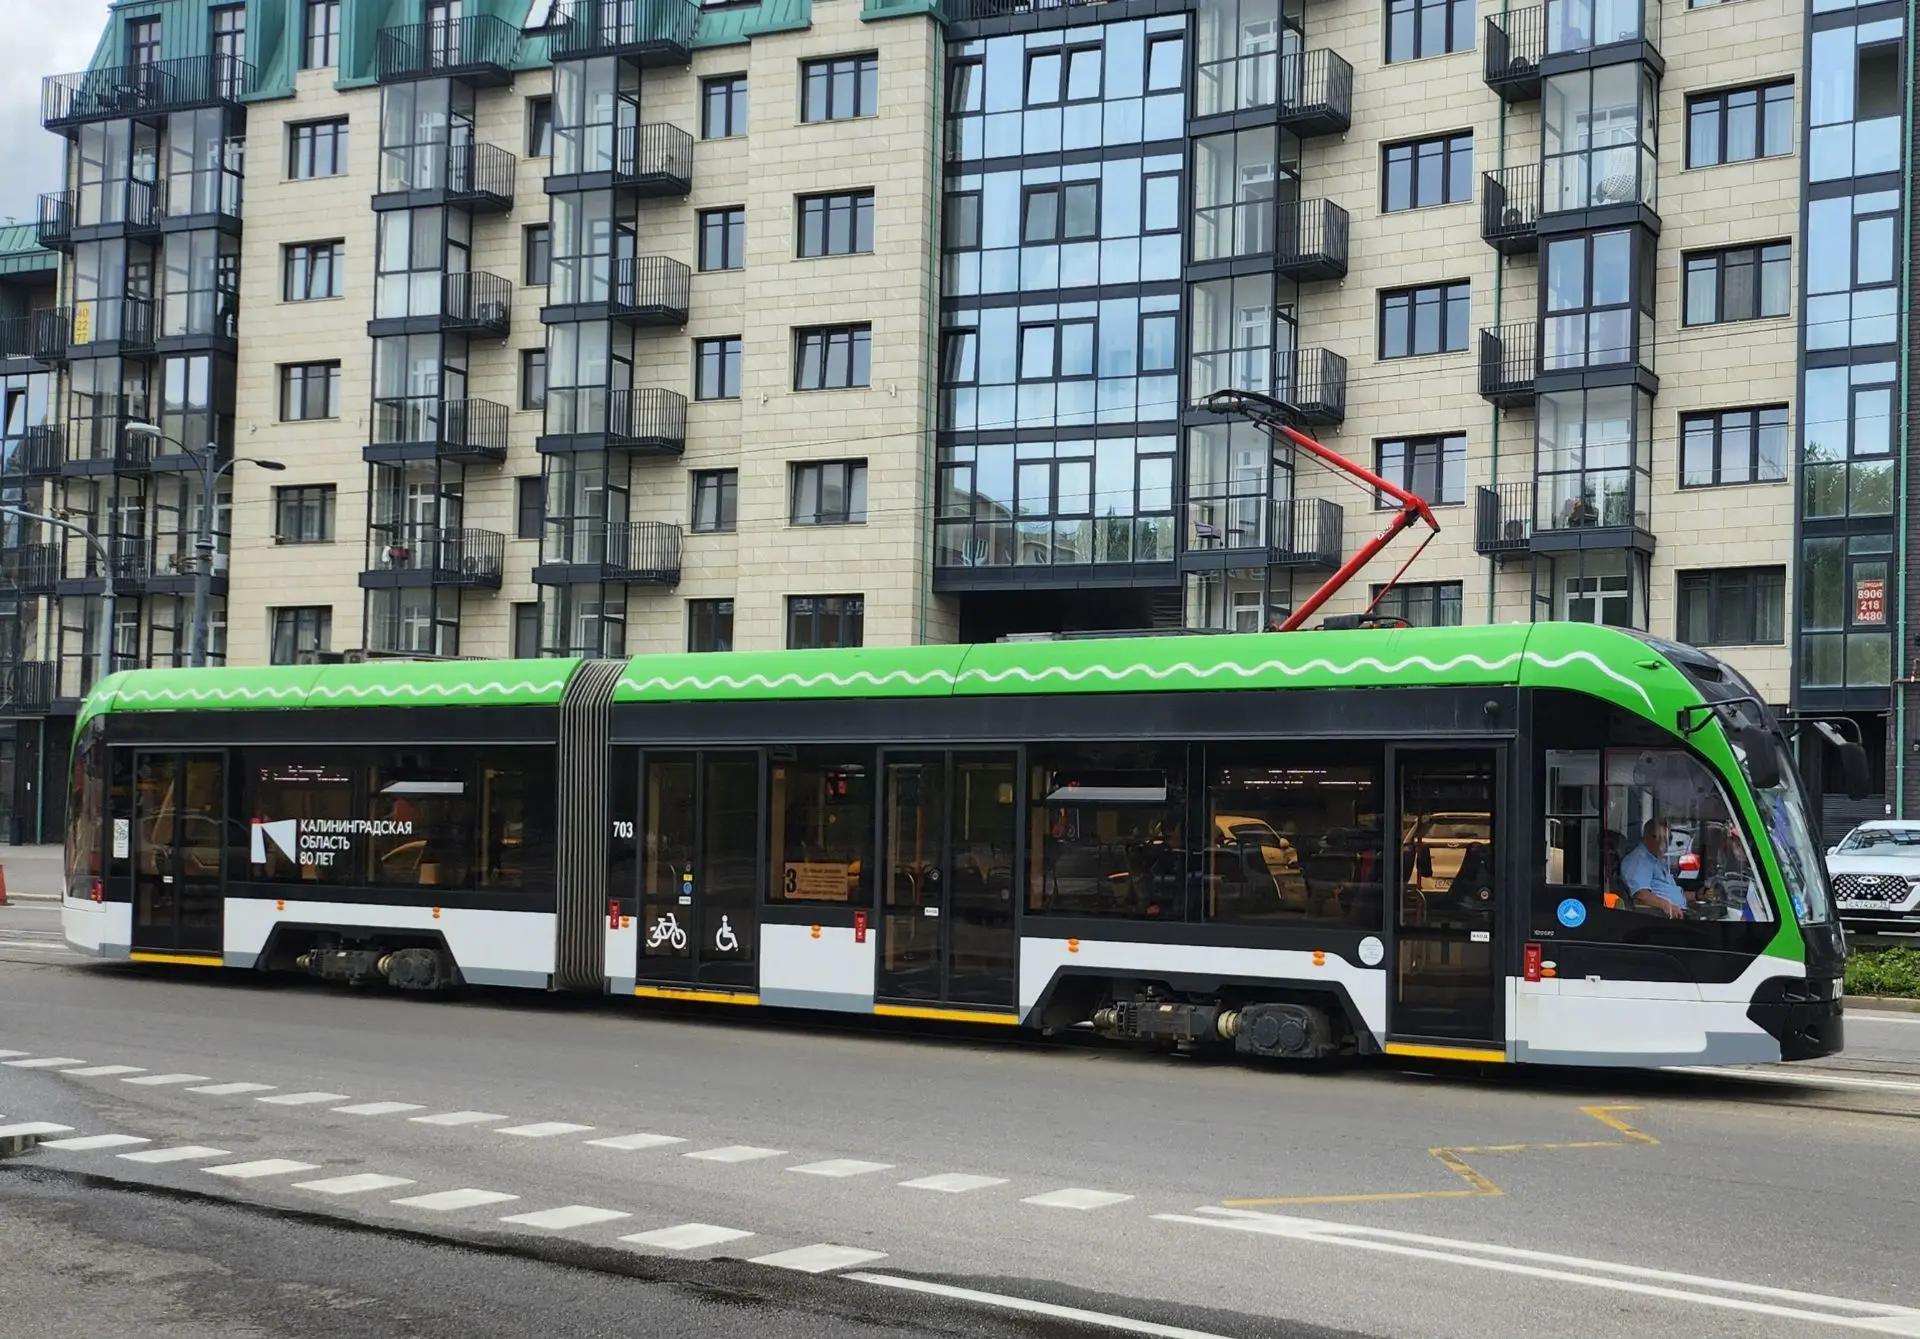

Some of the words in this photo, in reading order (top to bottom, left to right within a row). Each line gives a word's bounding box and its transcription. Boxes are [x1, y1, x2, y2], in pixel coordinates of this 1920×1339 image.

[1857, 589, 1883, 599] 8906
[1860, 600, 1880, 610] 218
[1857, 611, 1883, 621] 4480
[300, 819, 413, 836] КАЛИНИНГРАДСКАЯ
[612, 821, 633, 838] 703
[300, 836, 350, 850] ОБЛАСТЬ
[300, 852, 314, 865] 80
[315, 852, 335, 866] ЛЕТ
[786, 868, 797, 893] 3
